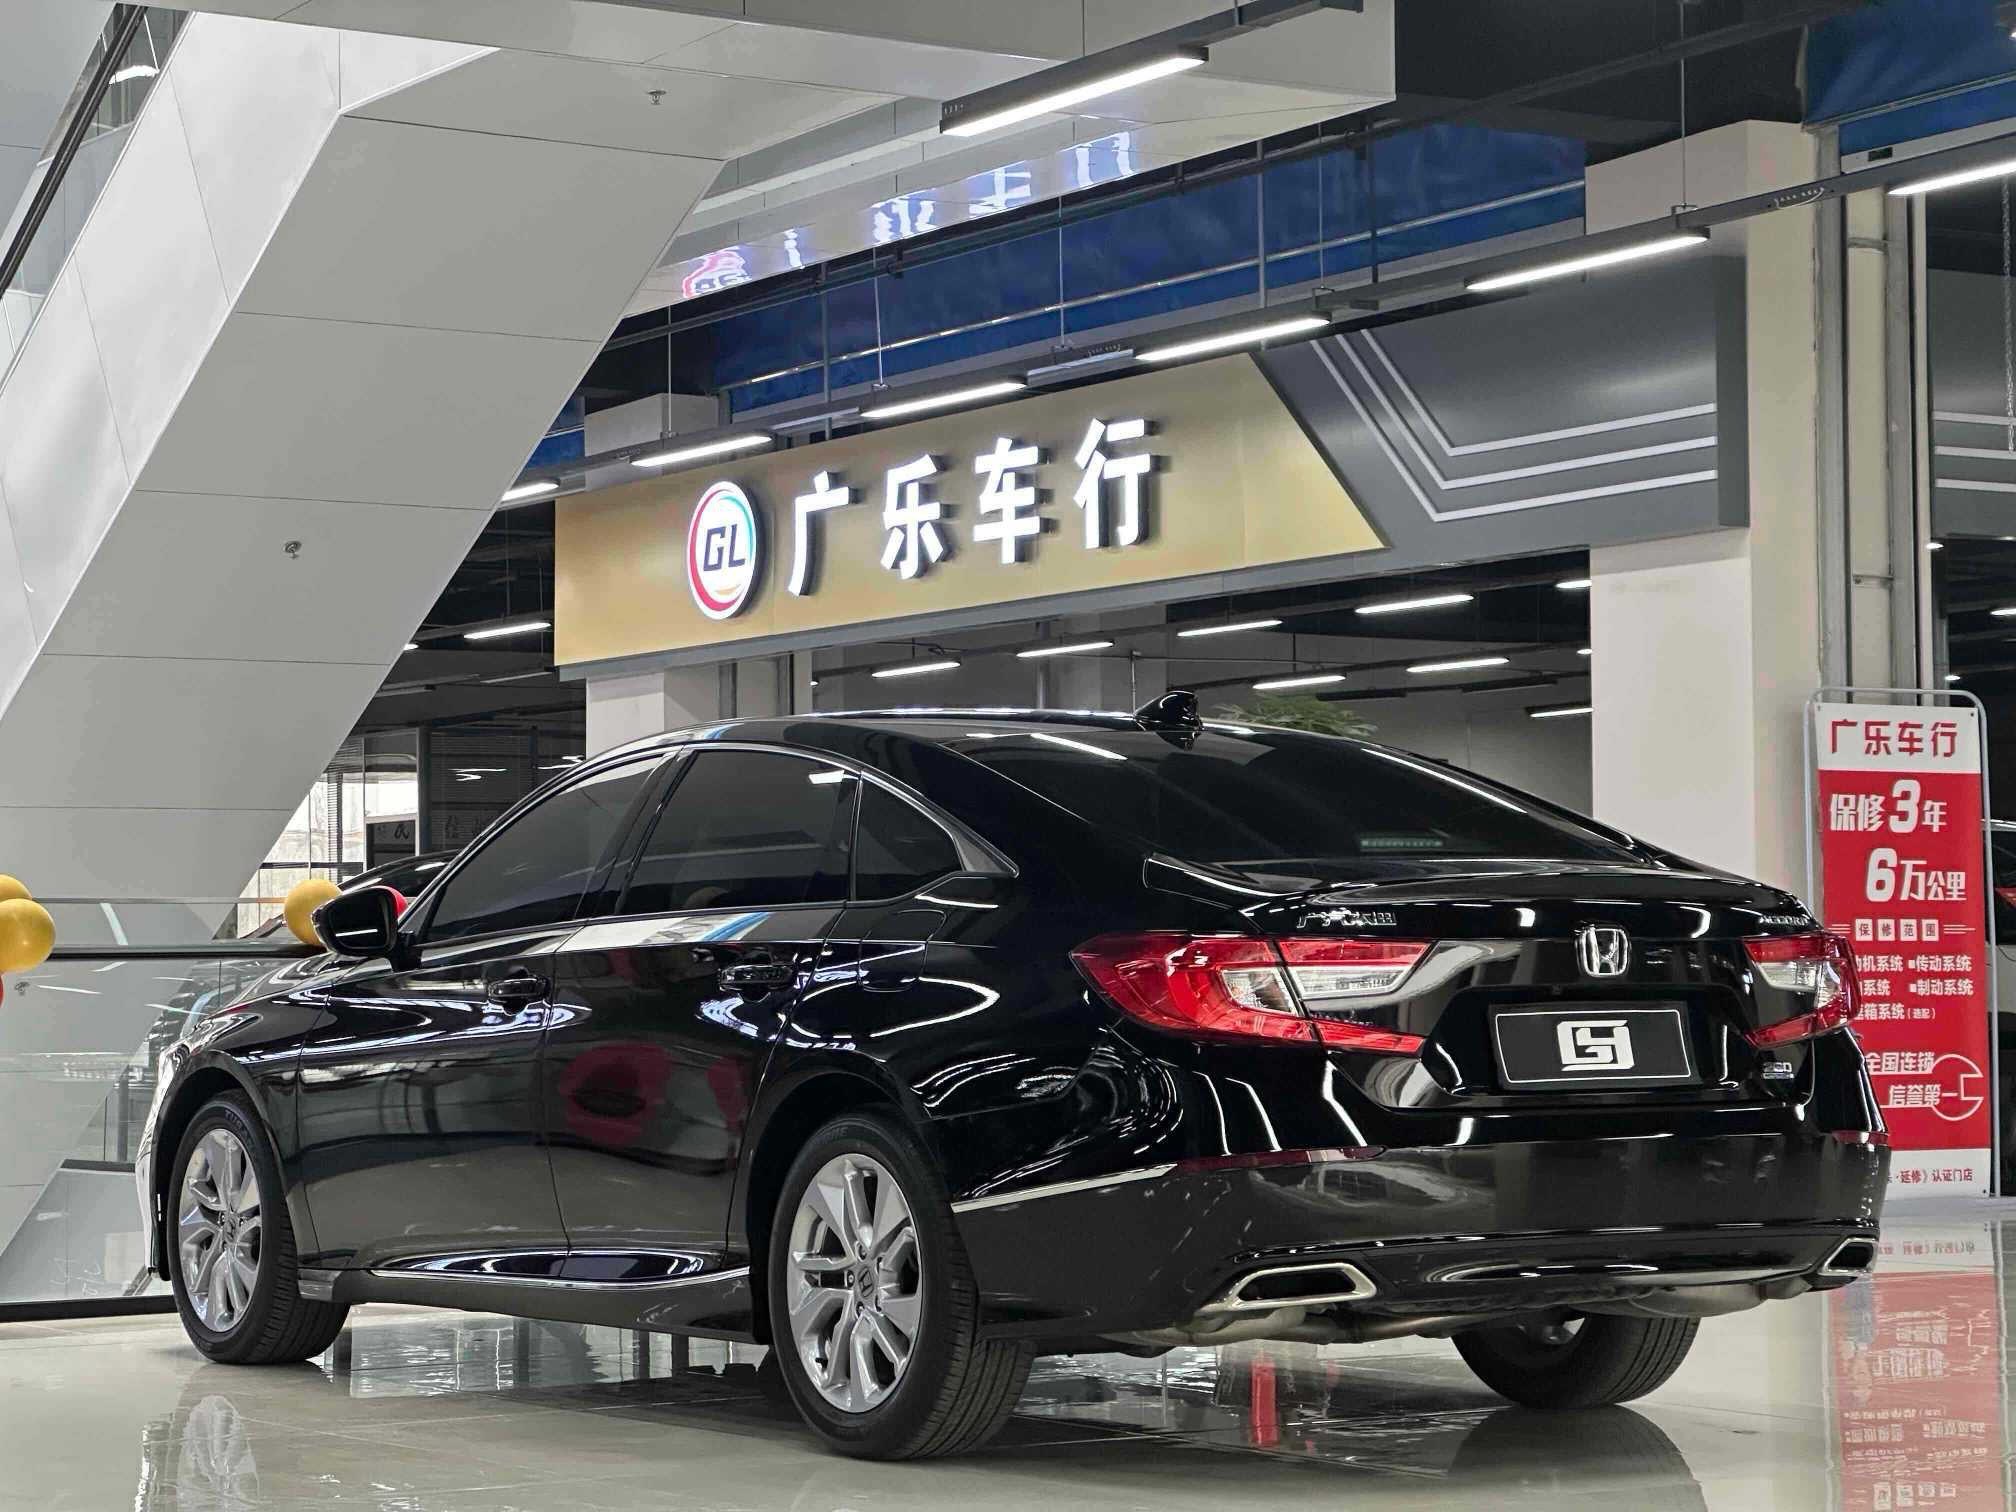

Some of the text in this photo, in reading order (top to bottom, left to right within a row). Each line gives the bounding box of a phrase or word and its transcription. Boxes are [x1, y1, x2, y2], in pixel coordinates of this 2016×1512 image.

[788, 418, 1152, 597] 广乐车行
[703, 523, 746, 572] GL
[1831, 718, 1957, 758] 广乐车行
[1830, 779, 1948, 834] 保修3年
[1866, 848, 1967, 902] 6万公里
[1860, 979, 1890, 996] 系统
[1916, 955, 1972, 972] 传动系统
